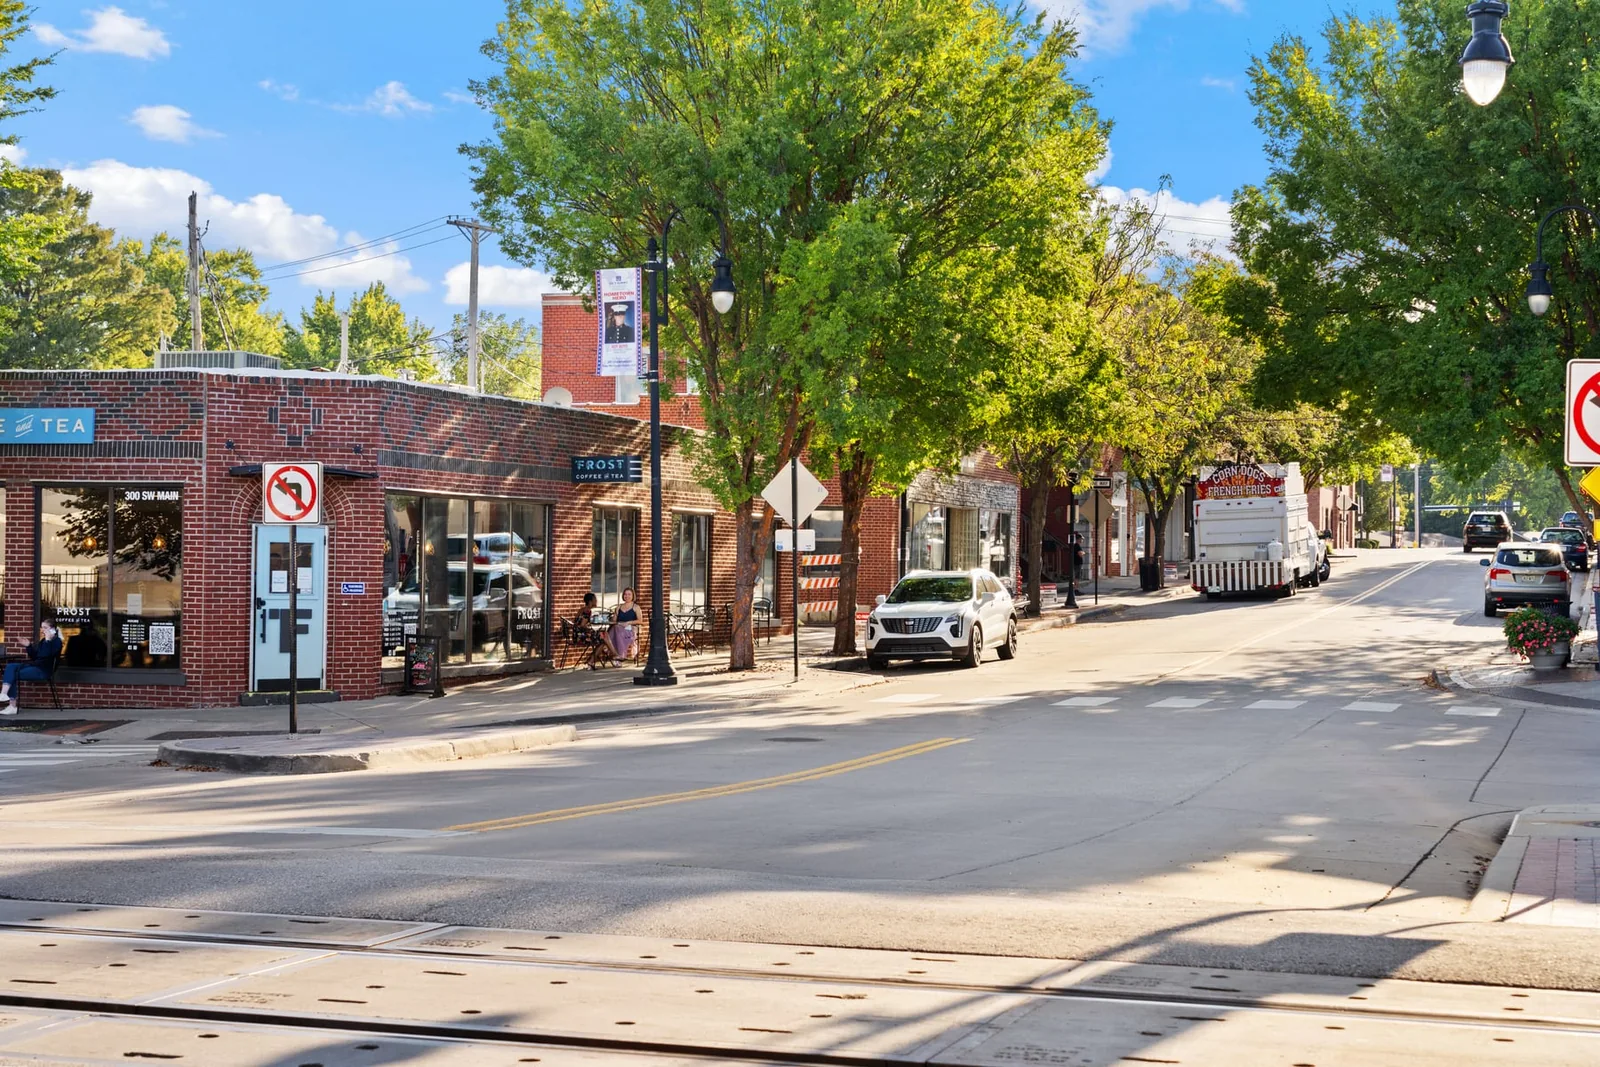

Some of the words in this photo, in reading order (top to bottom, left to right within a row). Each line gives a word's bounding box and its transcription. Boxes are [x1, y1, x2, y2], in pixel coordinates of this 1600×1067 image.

[15, 415, 34, 437] and
[41, 418, 85, 433] TEA
[575, 459, 624, 470] FROST
[1212, 465, 1238, 484] CORN
[1240, 464, 1266, 482] DOGS
[124, 490, 140, 501] 300
[141, 490, 155, 501] SW
[156, 490, 179, 501] MAIN
[1207, 484, 1243, 496] FRENCH
[1245, 483, 1272, 495] FRIES
[56, 607, 91, 616] FROST
[517, 607, 541, 620] FROST
